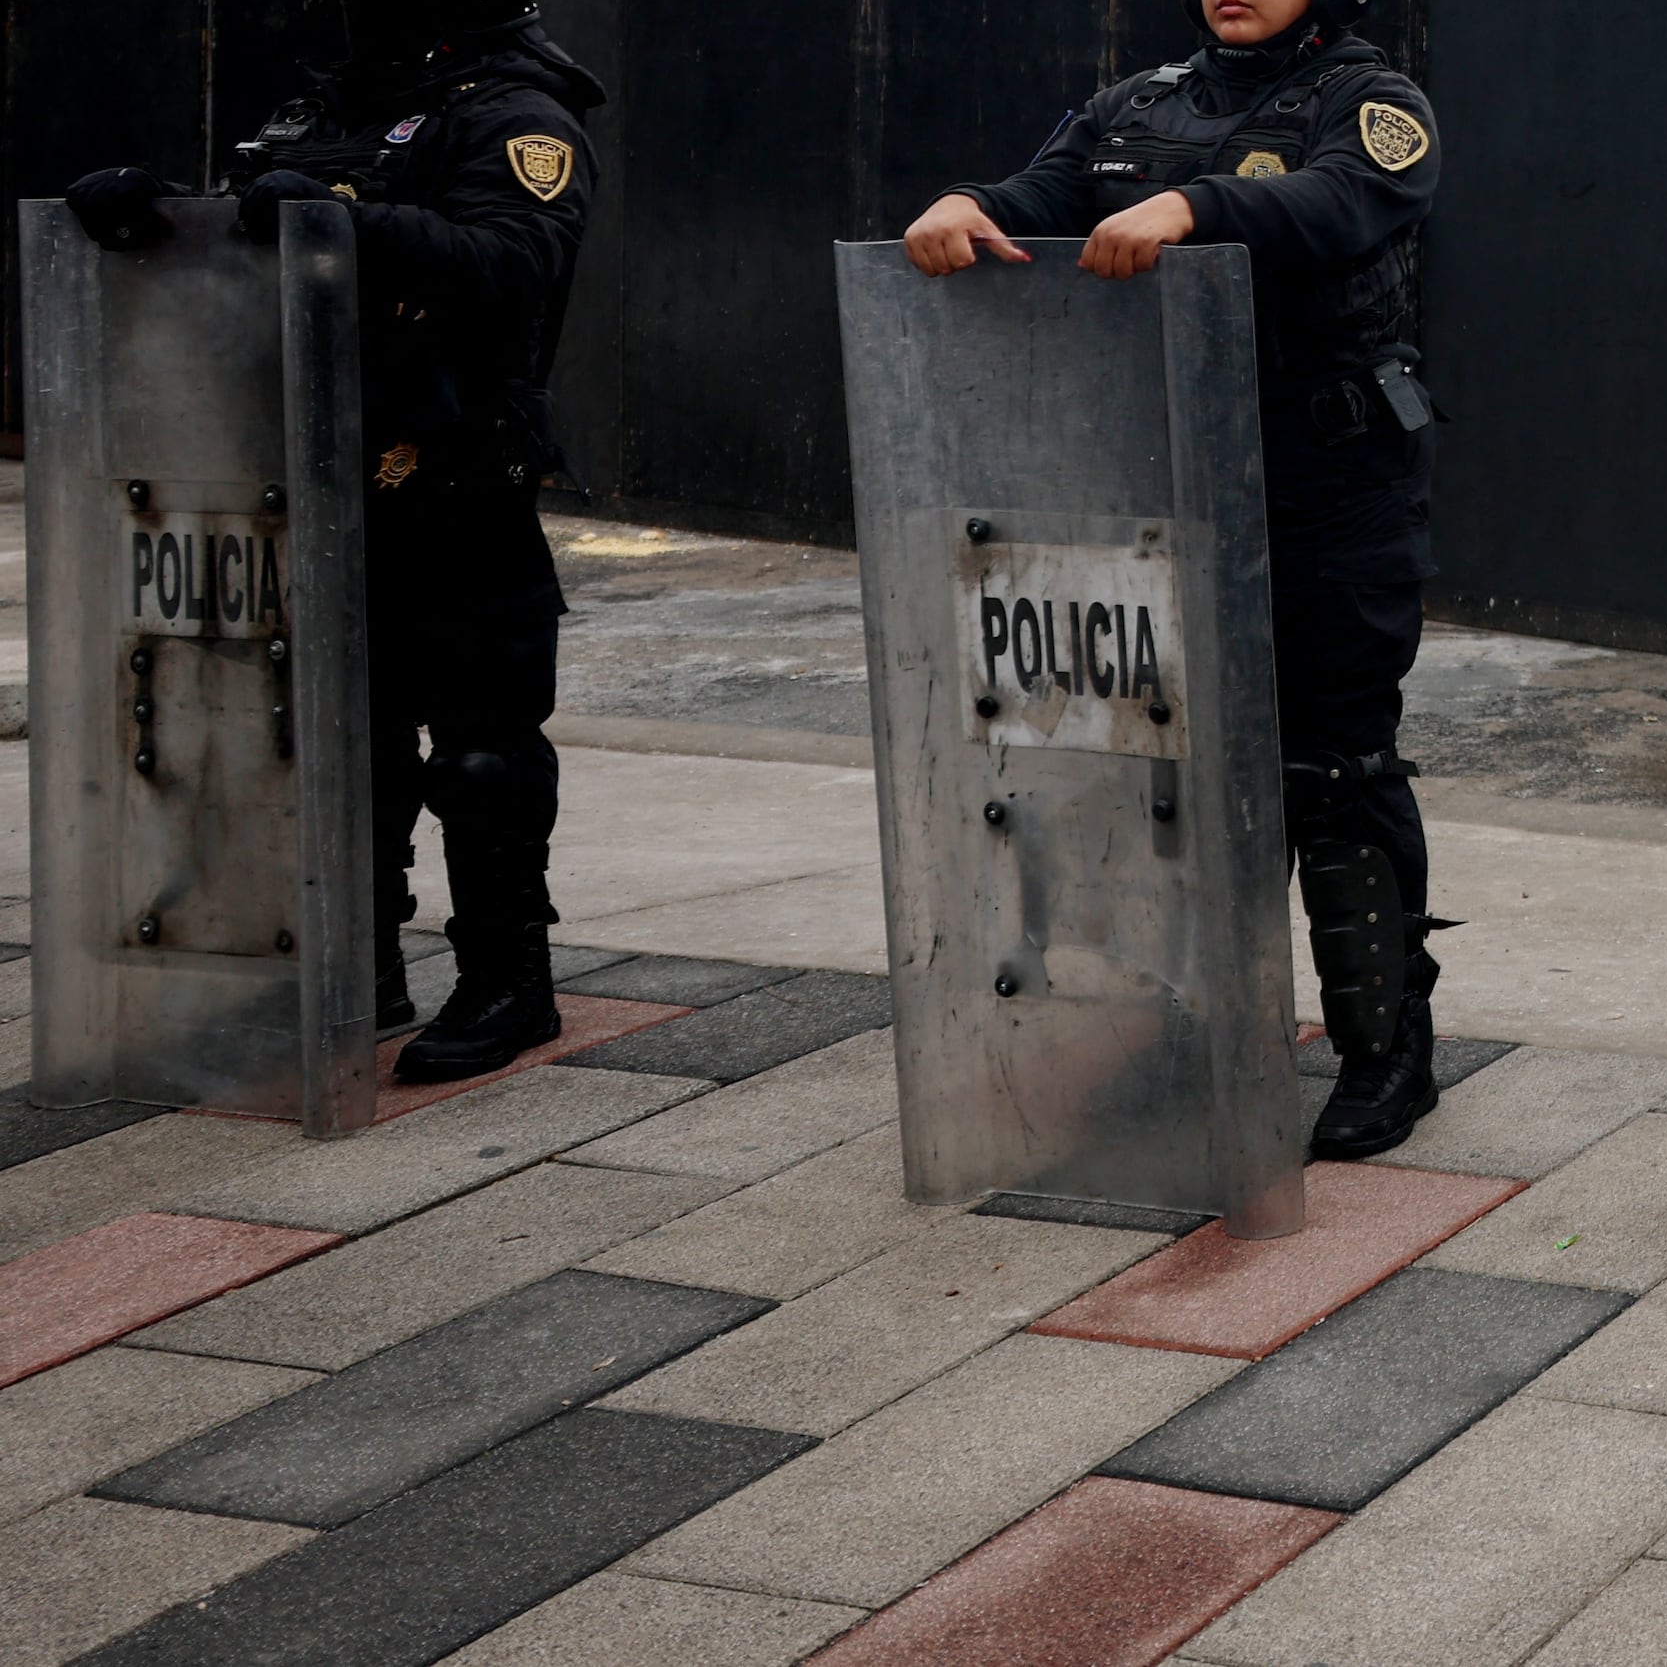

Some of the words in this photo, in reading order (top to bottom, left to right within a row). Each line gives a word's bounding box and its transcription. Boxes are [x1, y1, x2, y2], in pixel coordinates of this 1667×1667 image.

[516, 143, 564, 157] POLICIA
[1374, 110, 1418, 141] POLICIA
[133, 533, 282, 624] POLICIA
[981, 597, 1162, 702] POLICIA
